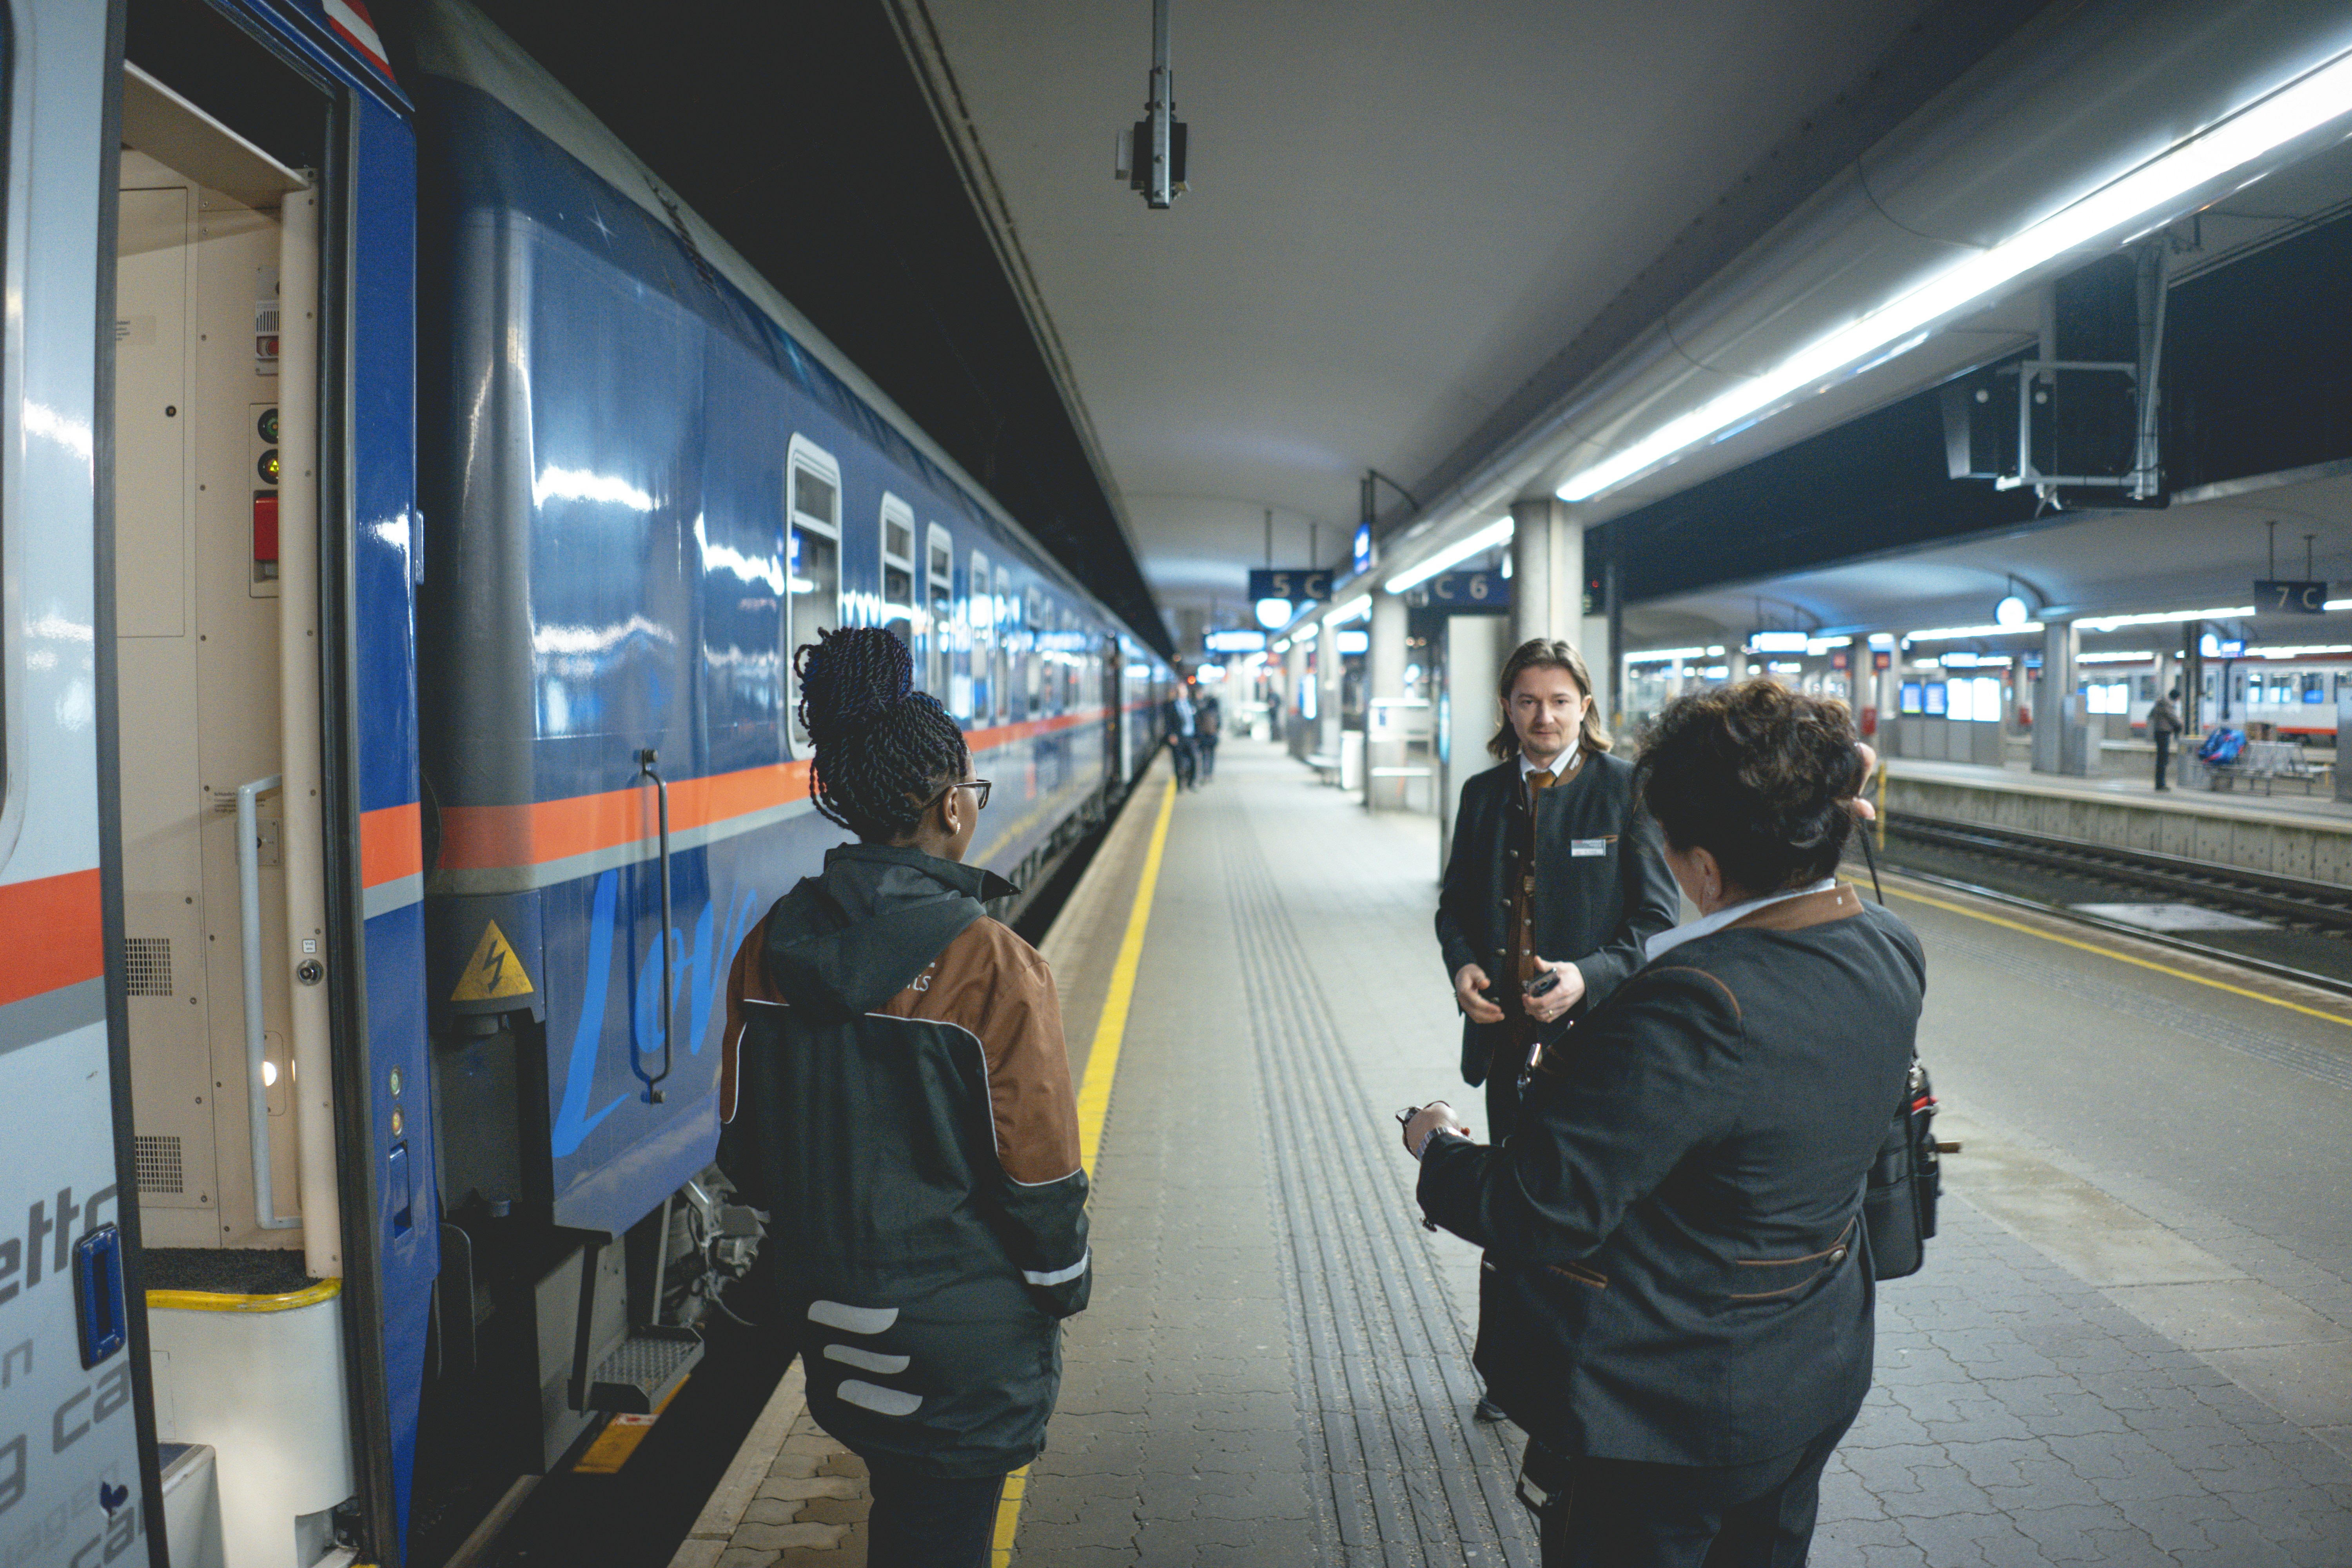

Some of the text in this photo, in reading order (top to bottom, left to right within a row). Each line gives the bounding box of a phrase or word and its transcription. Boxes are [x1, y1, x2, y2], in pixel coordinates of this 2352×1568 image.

[1273, 573, 1324, 599] 5 C
[1435, 574, 1488, 600] C 6
[2276, 587, 2318, 608] 7 C
